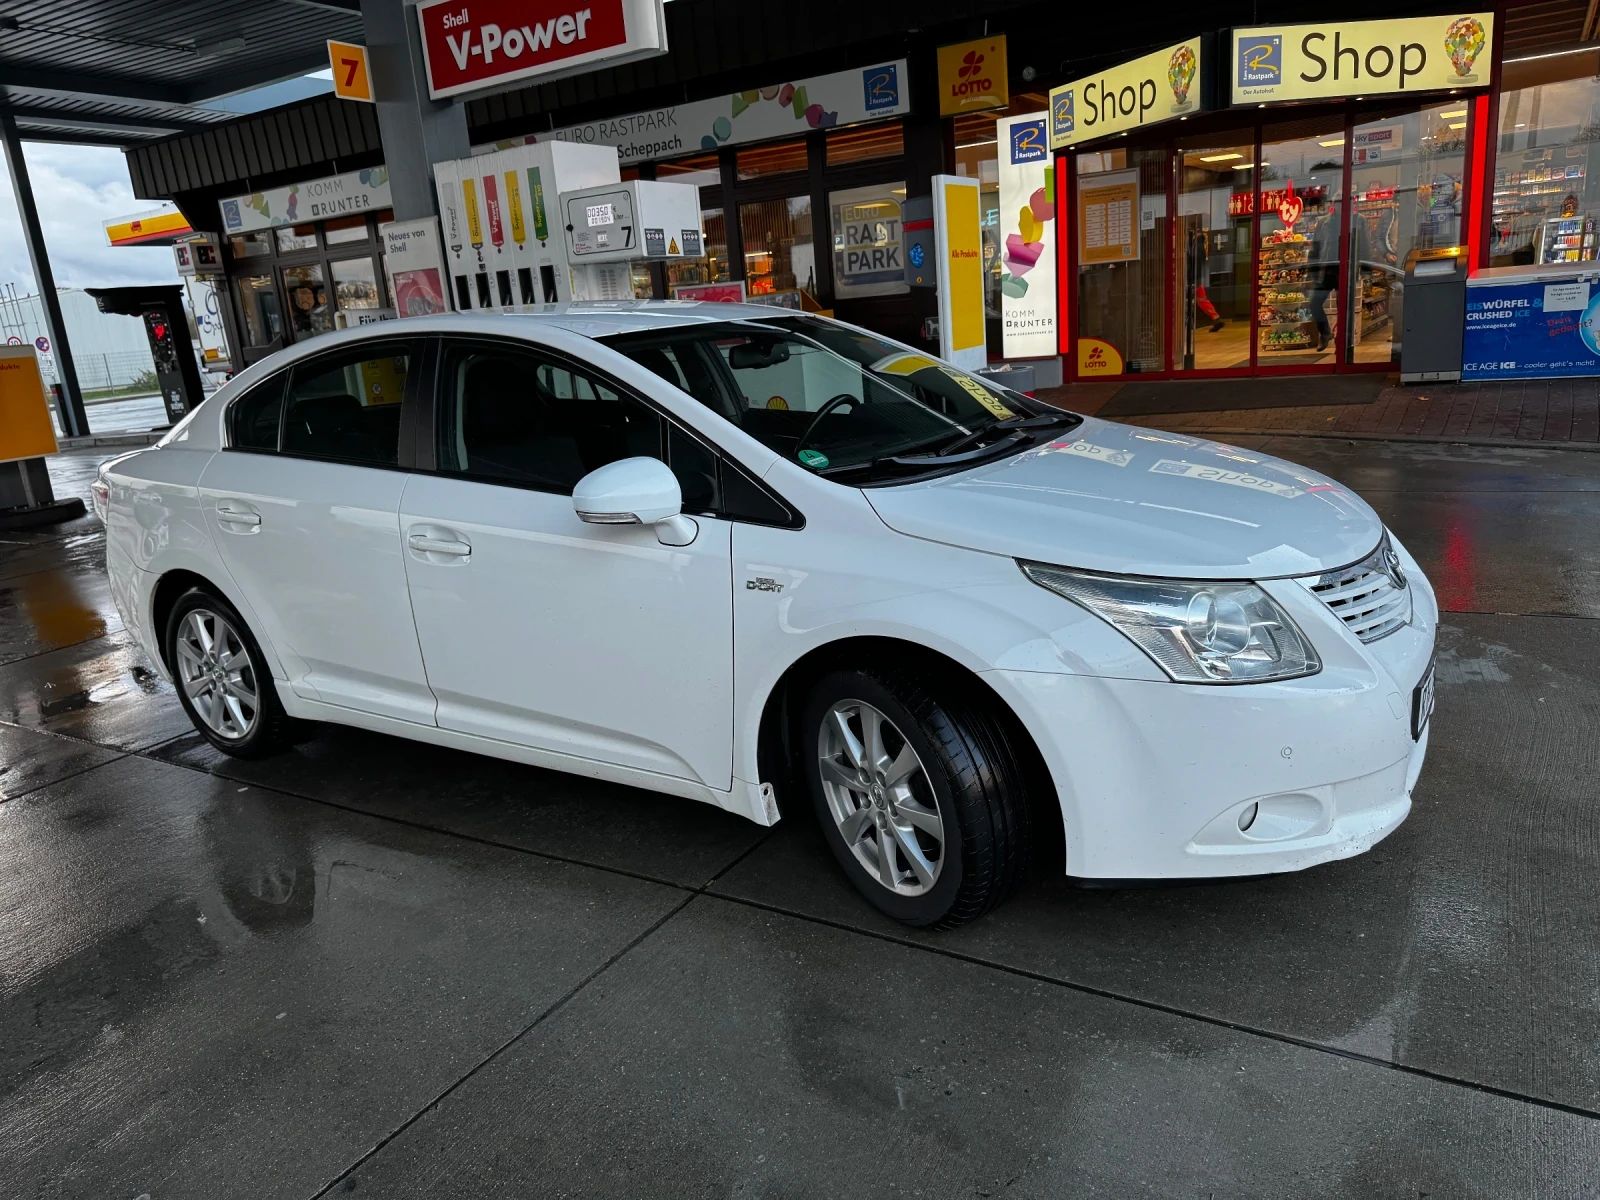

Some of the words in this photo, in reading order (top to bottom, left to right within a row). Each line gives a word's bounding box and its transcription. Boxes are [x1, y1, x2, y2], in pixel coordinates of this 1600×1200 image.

[442, 8, 469, 29] Shell
[446, 8, 592, 71] V-Power
[1300, 32, 1427, 89] Shop
[341, 58, 358, 87] 7
[1248, 72, 1274, 81] Rastpark
[952, 77, 992, 97] LOTTO
[1083, 78, 1157, 126] Shop
[598, 108, 678, 138] RASTPARK
[1369, 131, 1390, 141] sport
[616, 135, 682, 160] Scheppach
[1018, 150, 1042, 160] Rastpark
[306, 178, 344, 198] KOMM
[512, 205, 520, 231] Super
[534, 204, 542, 228] Super
[845, 206, 880, 221] EURO
[1279, 200, 1299, 222] ty
[388, 231, 410, 242] Neues
[411, 229, 426, 239] von
[620, 226, 632, 248] 7
[845, 219, 899, 246] RAST
[390, 242, 407, 254] Shell
[951, 250, 959, 258] Alle
[959, 249, 978, 259] Produkte
[847, 246, 901, 272] PARK
[1005, 309, 1035, 319] KOMM
[1466, 299, 1530, 311] EISWÜRFEL
[1466, 310, 1513, 321] CRUSHED
[1514, 309, 1531, 318] ICE
[1465, 322, 1517, 331] www.iceageice.de
[1547, 316, 1572, 328] Dran
[1549, 318, 1594, 338] gedacht?
[1084, 360, 1107, 368] LOTTO
[1463, 363, 1478, 371] ICE
[1478, 362, 1498, 370] AGE
[1499, 361, 1516, 370] ICE
[1523, 361, 1548, 369] cooler
